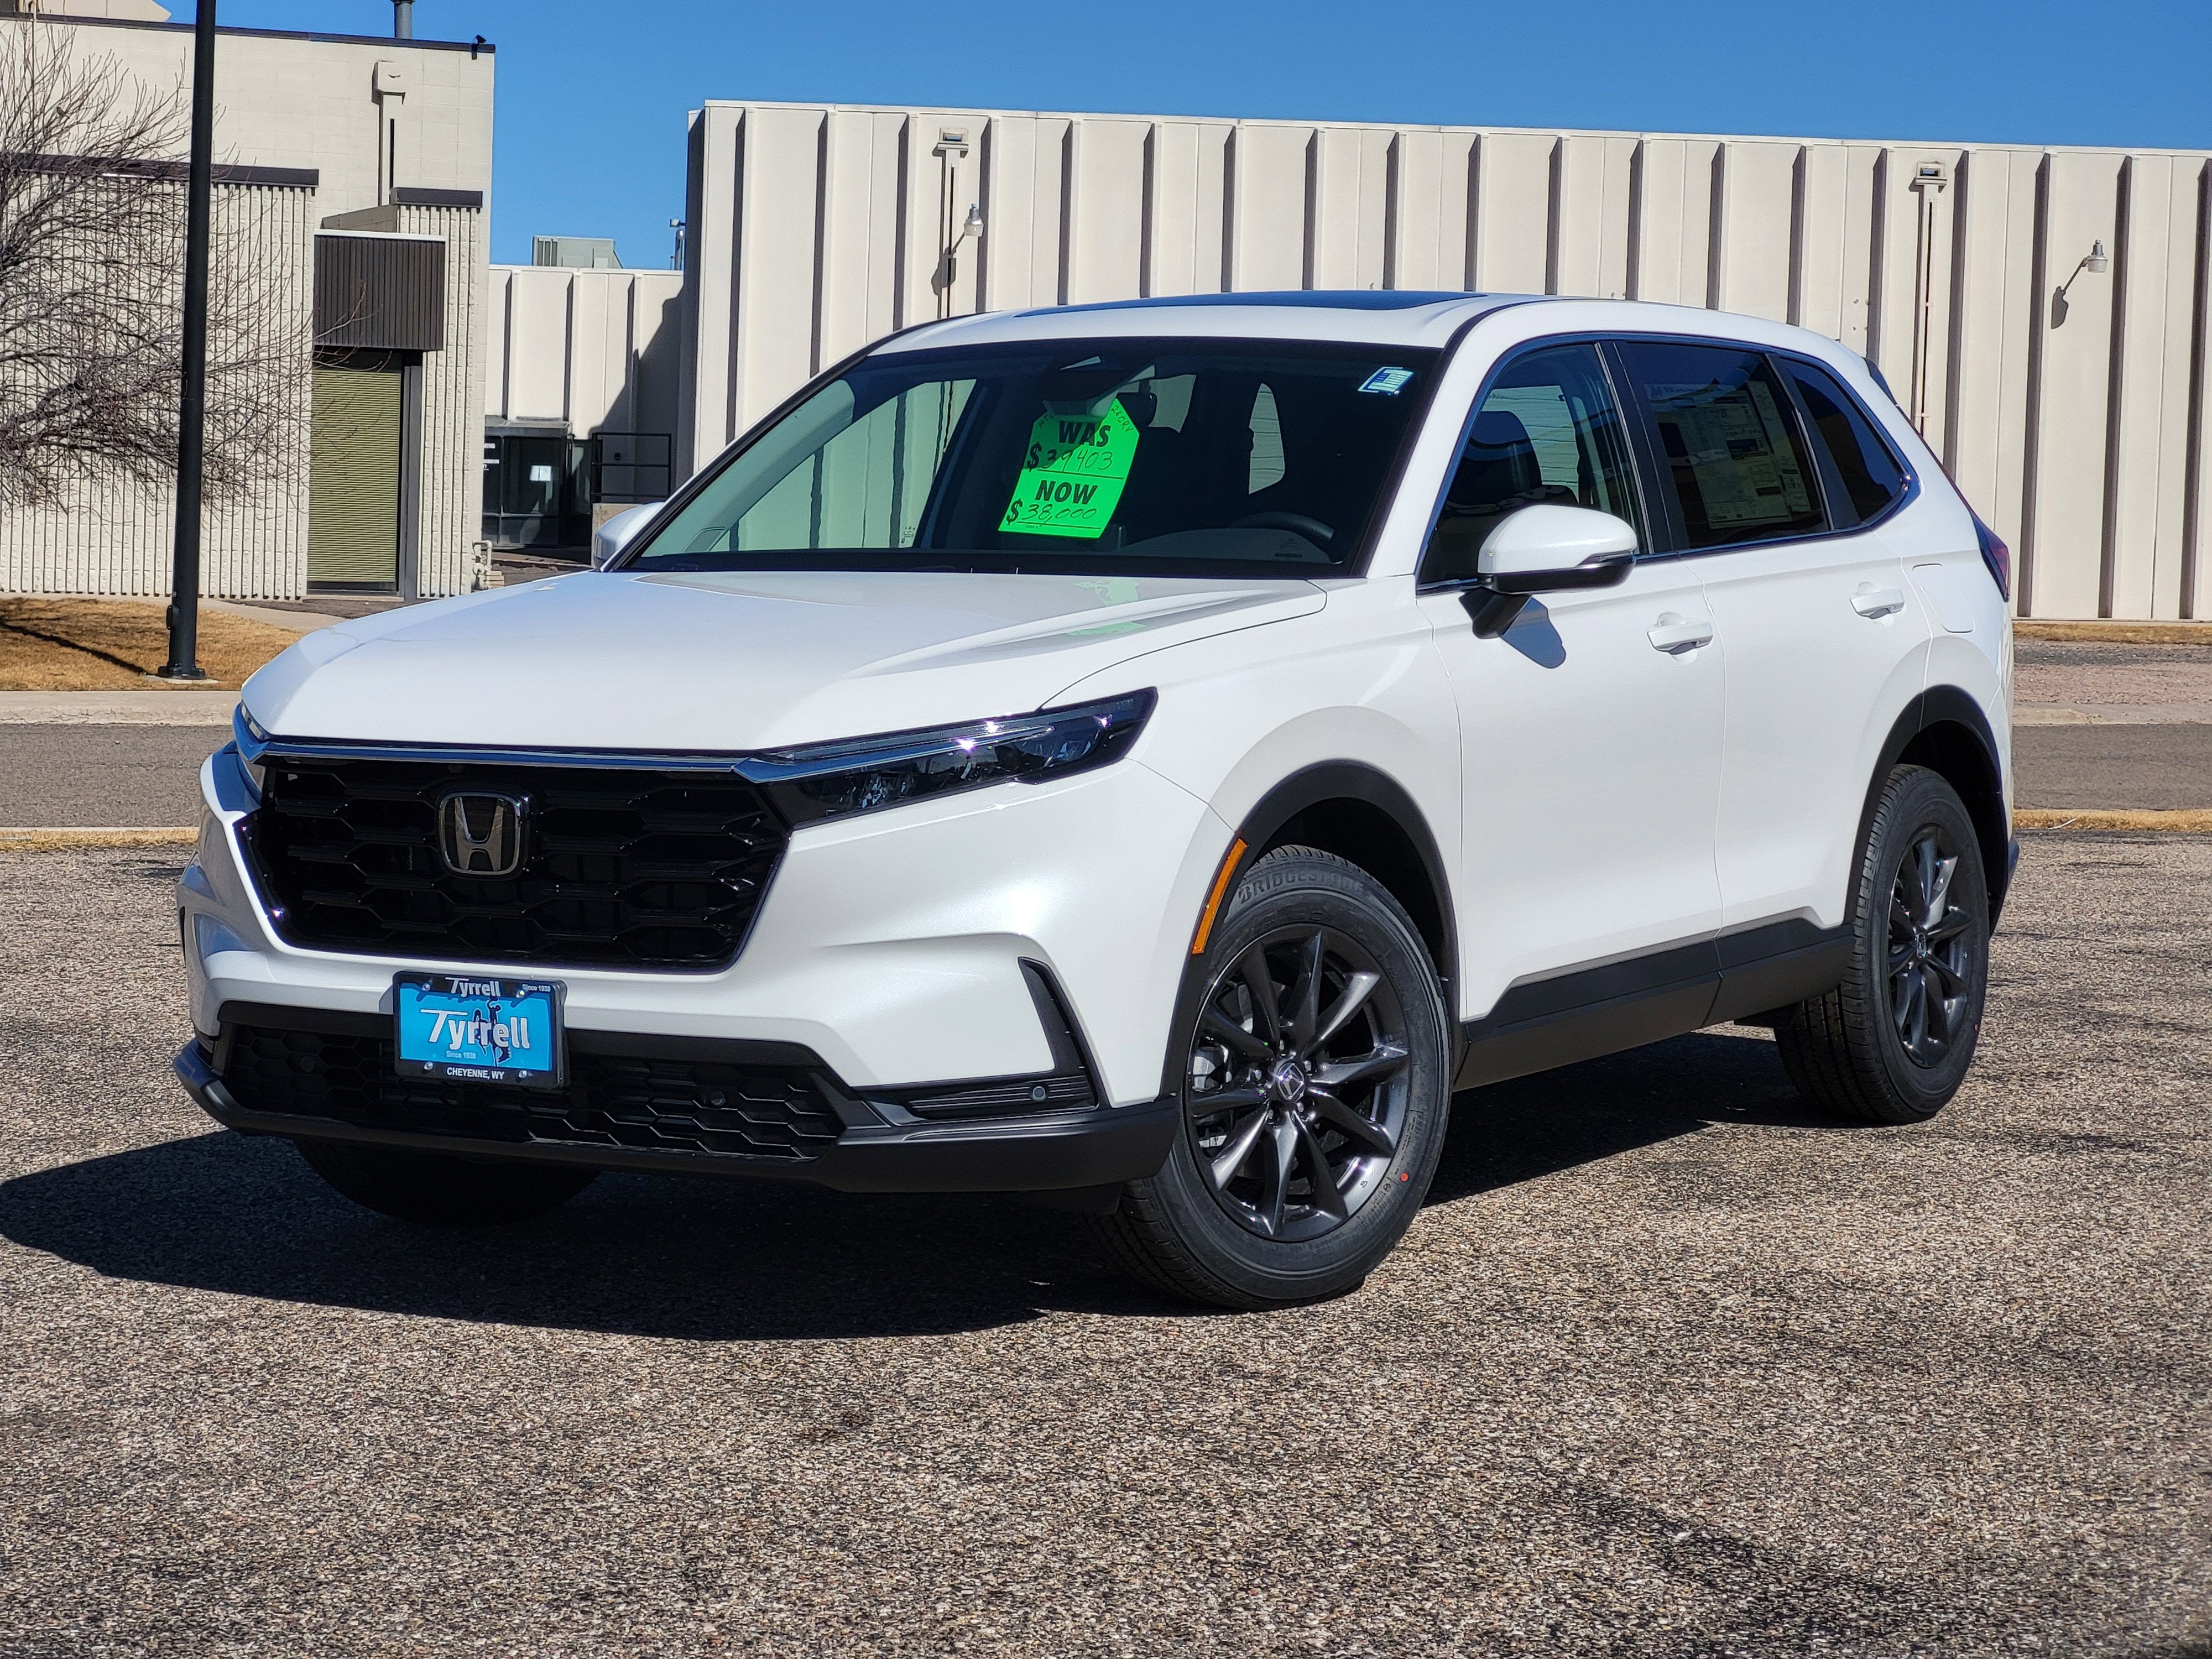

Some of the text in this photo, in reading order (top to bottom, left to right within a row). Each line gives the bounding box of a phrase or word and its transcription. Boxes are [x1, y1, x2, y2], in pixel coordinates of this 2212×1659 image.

[1058, 420, 1111, 447] WAS
[1035, 479, 1098, 505] NOW
[445, 977, 500, 998] Tyrrell
[420, 1009, 530, 1050] Tyrrell
[447, 1067, 504, 1080] CHEYENNE, WY
